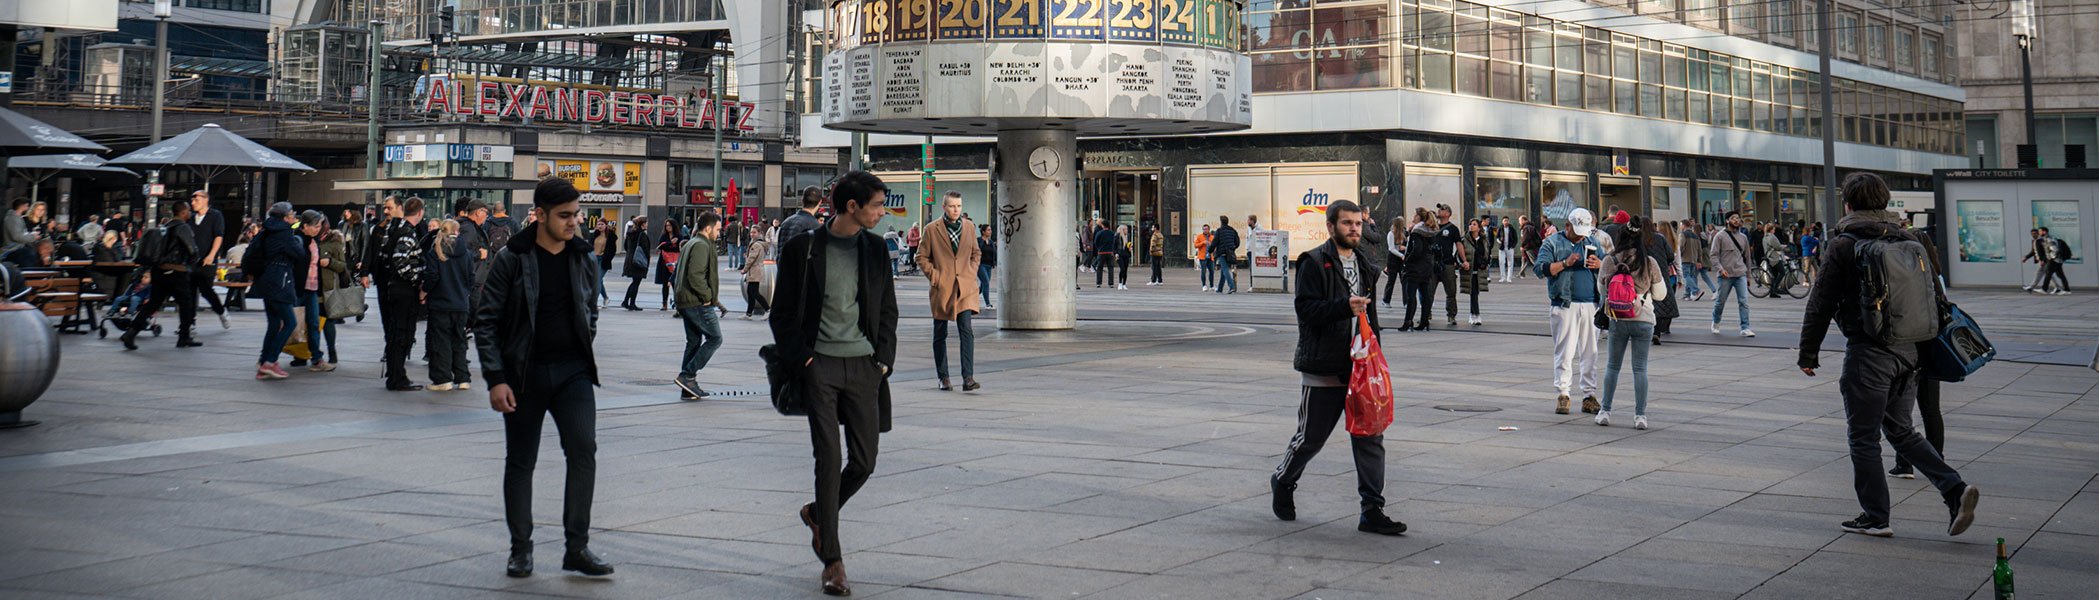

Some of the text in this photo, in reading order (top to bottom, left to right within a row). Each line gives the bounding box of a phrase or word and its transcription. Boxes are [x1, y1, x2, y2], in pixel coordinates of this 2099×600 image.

[863, 1, 888, 34] 18
[899, 0, 932, 30] 19
[939, 0, 987, 28] 20
[998, 0, 1039, 26] 21
[1053, 0, 1102, 27] 22
[1110, 0, 1152, 29] 23
[1162, 0, 1194, 32] 24
[425, 79, 756, 131] ALEXANDERPLATZ
[385, 146, 394, 161] U
[450, 145, 459, 159] U
[579, 193, 624, 202] cDonald's
[1302, 188, 1329, 206] dm
